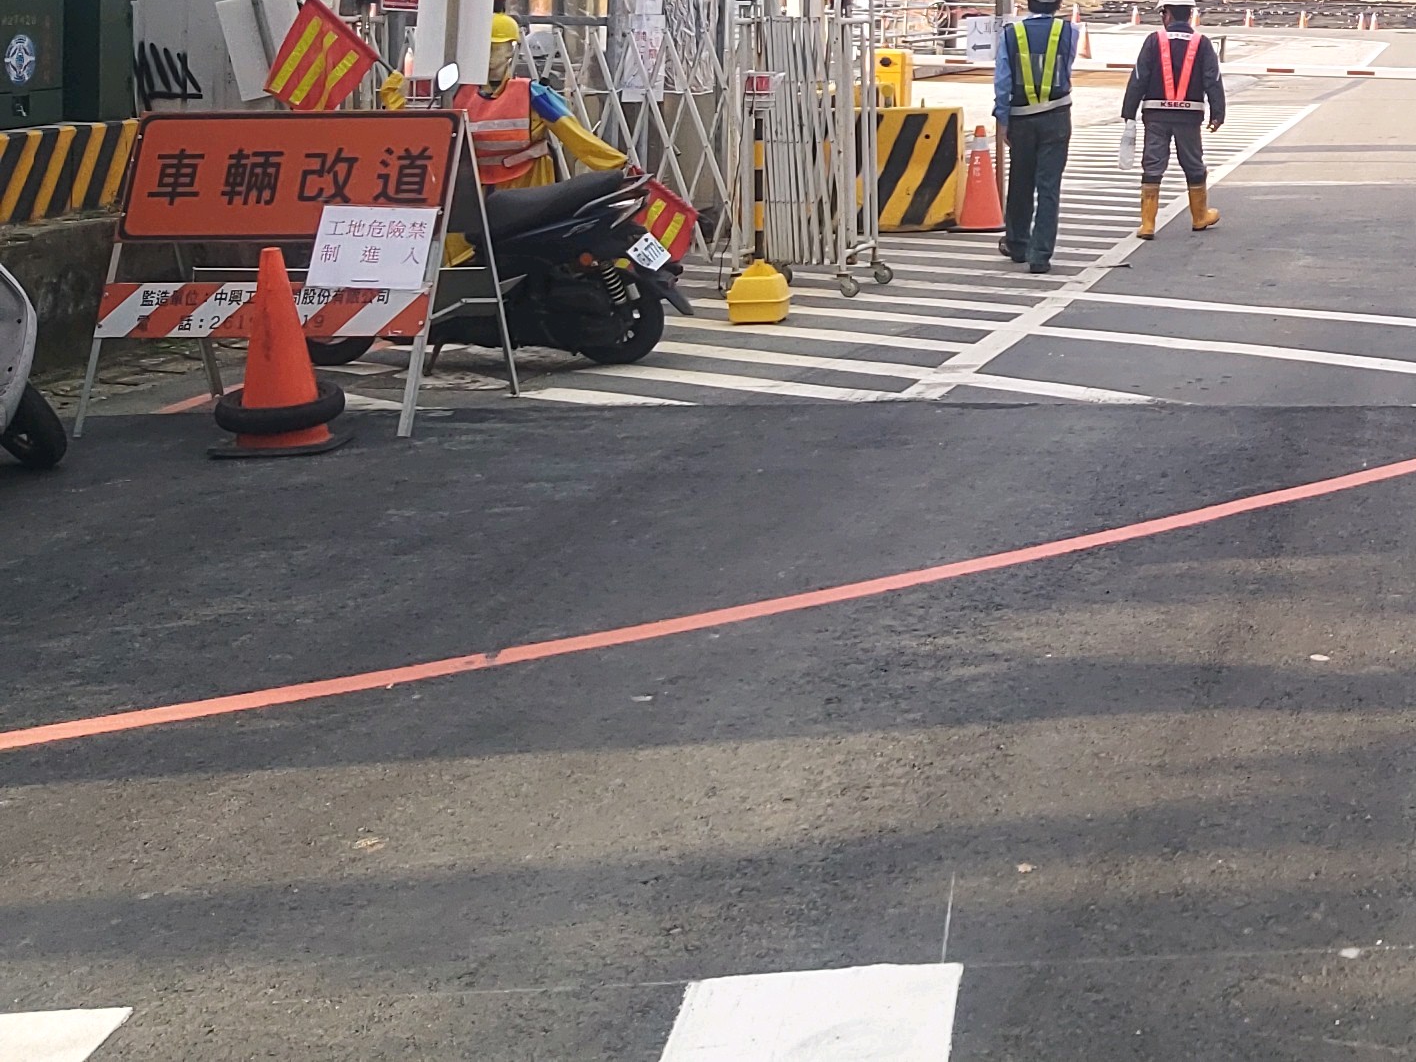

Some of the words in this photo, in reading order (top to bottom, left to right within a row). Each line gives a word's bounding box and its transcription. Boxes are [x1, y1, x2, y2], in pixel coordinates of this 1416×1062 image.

[147, 147, 432, 206] 車輛改道
[324, 219, 427, 239] 工地危險禁
[320, 244, 419, 265] 制進入
